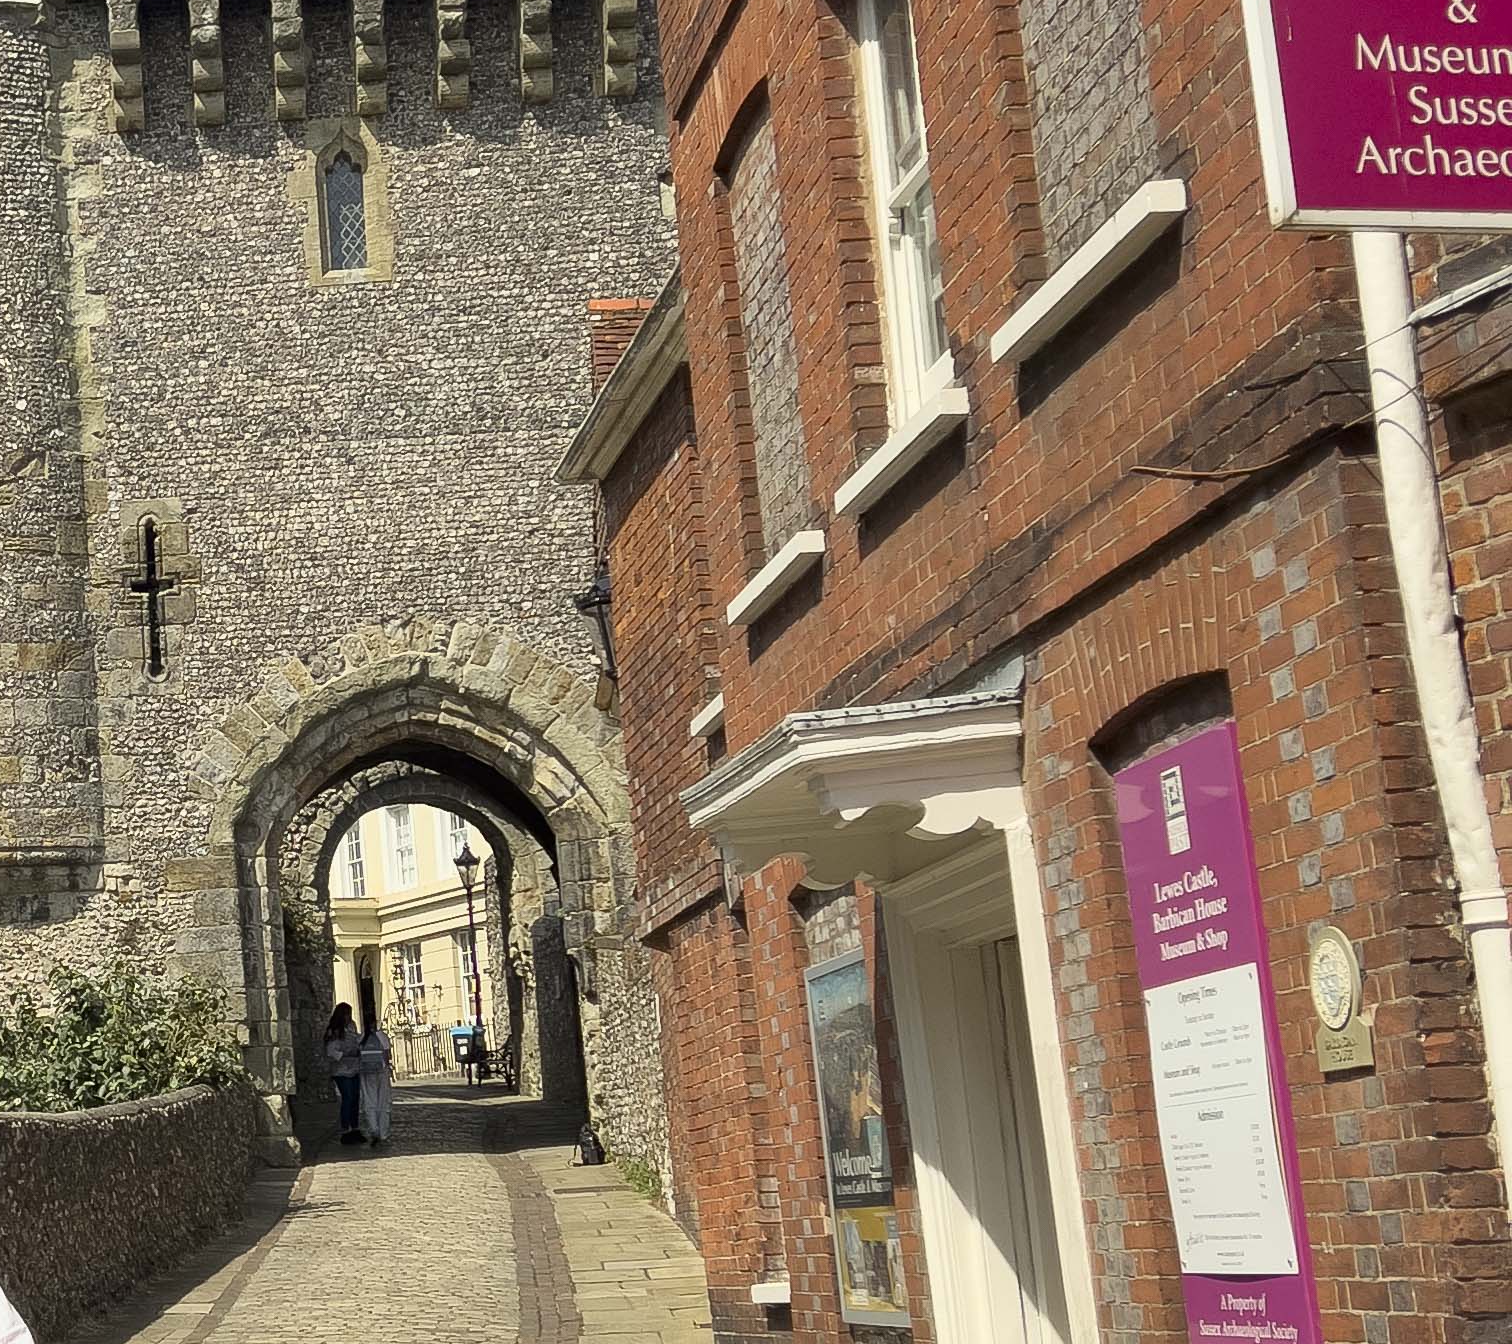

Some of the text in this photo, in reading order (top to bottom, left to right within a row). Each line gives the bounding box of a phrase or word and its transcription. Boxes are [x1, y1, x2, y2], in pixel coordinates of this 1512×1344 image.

[1153, 865, 1219, 904] Lewes Castle,
[1152, 897, 1228, 934] Barbican House
[1160, 927, 1229, 961] Museum & Shop
[832, 1148, 873, 1176] Welcome
[1220, 1292, 1267, 1316] A Property of
[1199, 1319, 1222, 1337] Sussex
[1221, 1319, 1273, 1344] Archaeological
